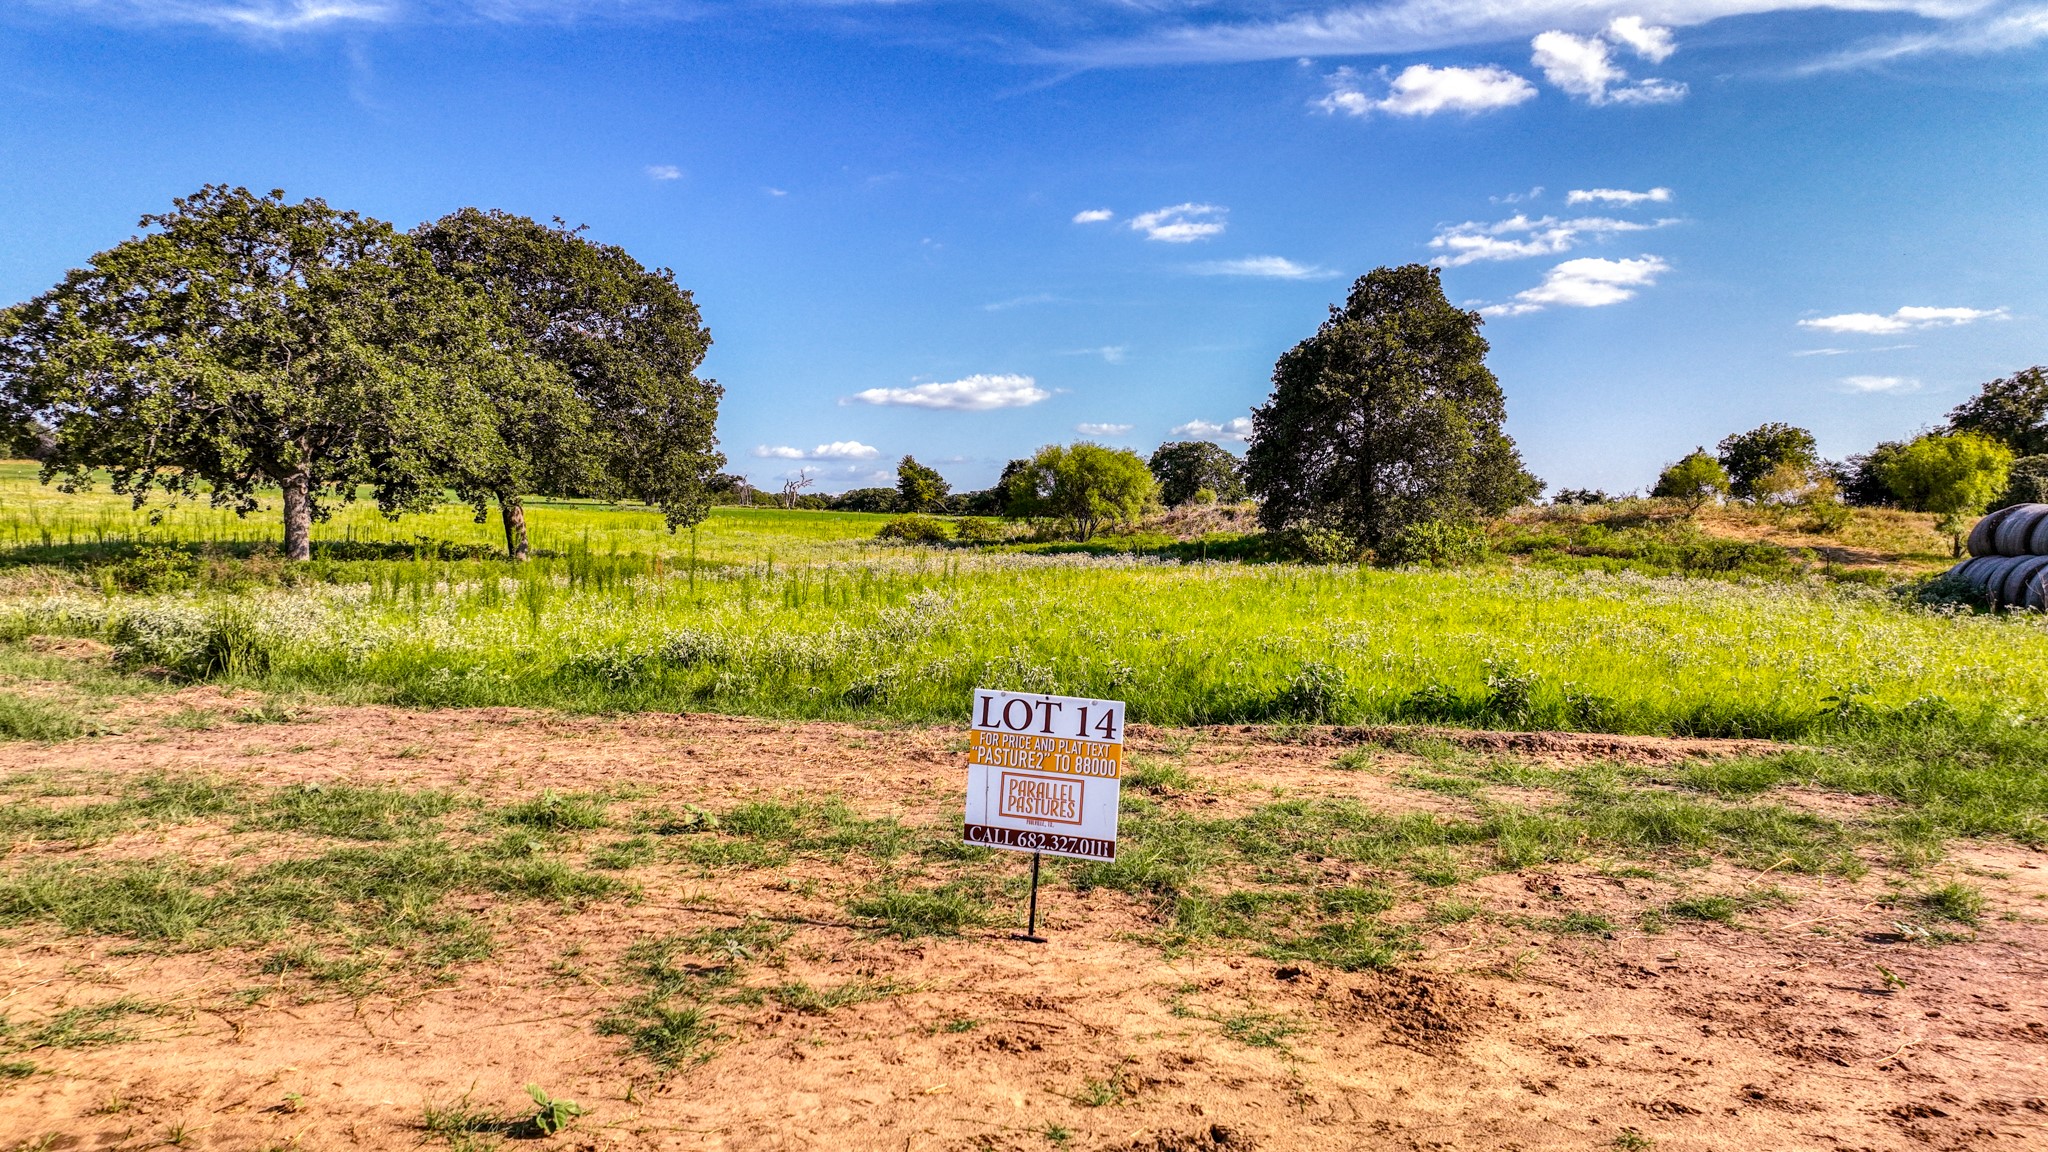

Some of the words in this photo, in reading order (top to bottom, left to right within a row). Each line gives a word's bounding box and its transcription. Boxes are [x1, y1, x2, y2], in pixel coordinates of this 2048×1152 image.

[978, 695, 1062, 733] LOT
[1076, 706, 1117, 740] 14
[979, 731, 999, 746] FOR
[1002, 733, 1031, 750] PRICE
[1034, 737, 1055, 752] AND
[1058, 740, 1083, 755] PLAT
[1085, 743, 1111, 757] TEXT
[1054, 754, 1071, 771] TO
[1075, 757, 1117, 777] 88000
[1009, 778, 1073, 801] PARALLEL
[1007, 795, 1075, 818] PASTURES
[969, 825, 1014, 846] CALL
[1017, 831, 1109, 858] 682.327.0111
